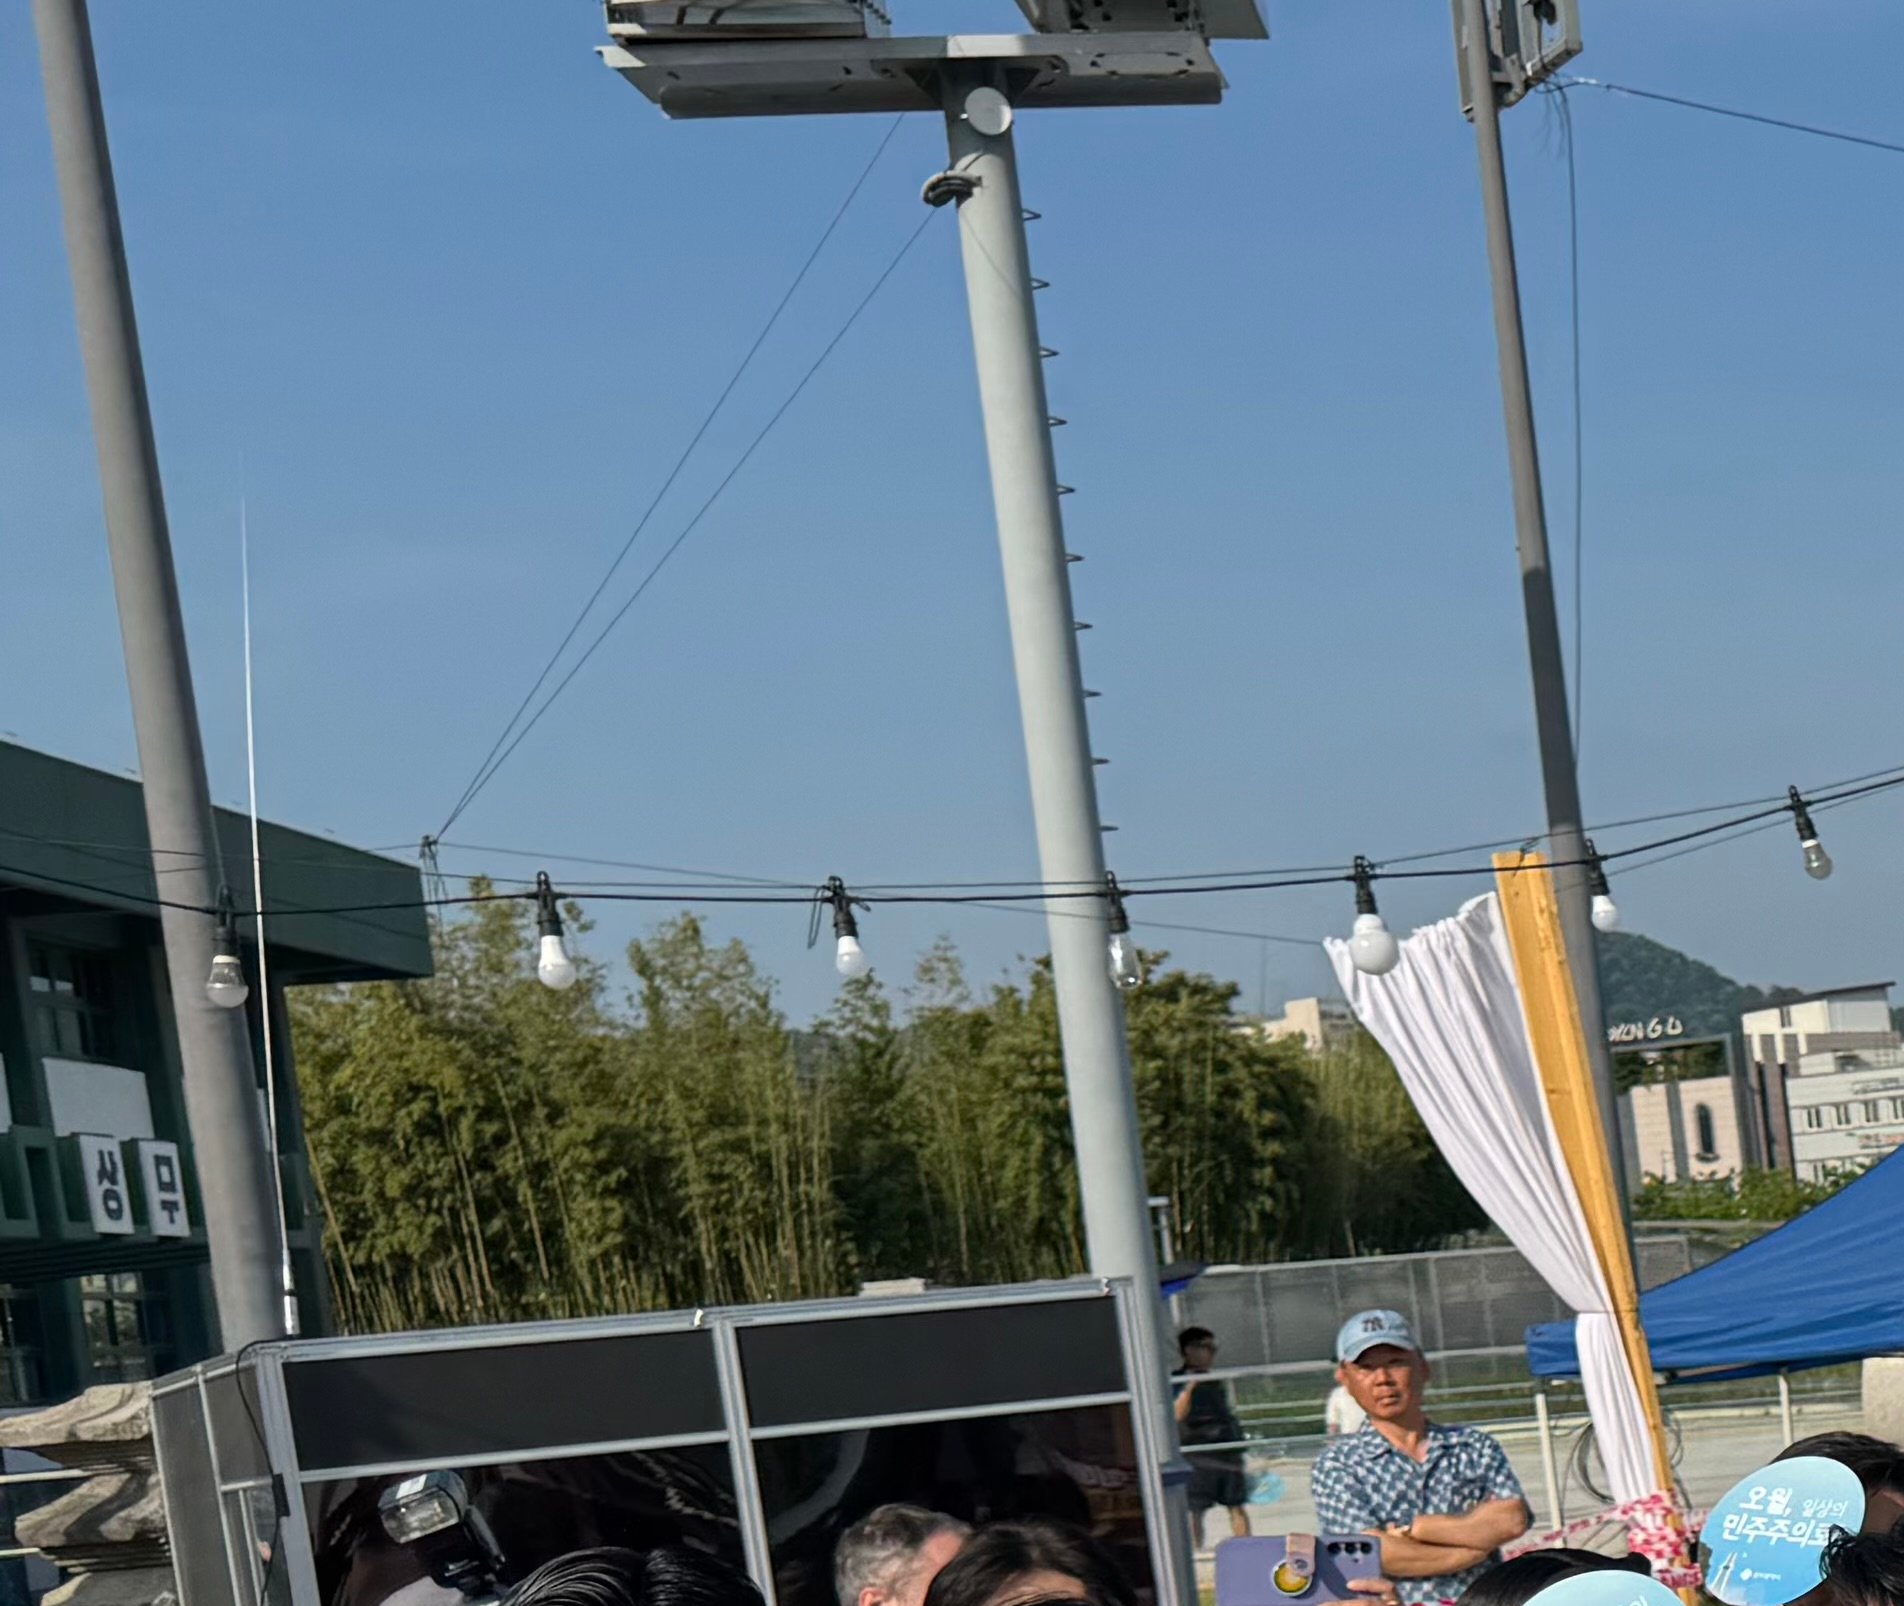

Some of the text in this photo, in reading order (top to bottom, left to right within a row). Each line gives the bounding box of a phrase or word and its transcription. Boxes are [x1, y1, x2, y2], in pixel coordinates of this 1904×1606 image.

[1739, 1485, 1849, 1519] 오월, 일상의
[1721, 1512, 1830, 1548] 민주주의로
